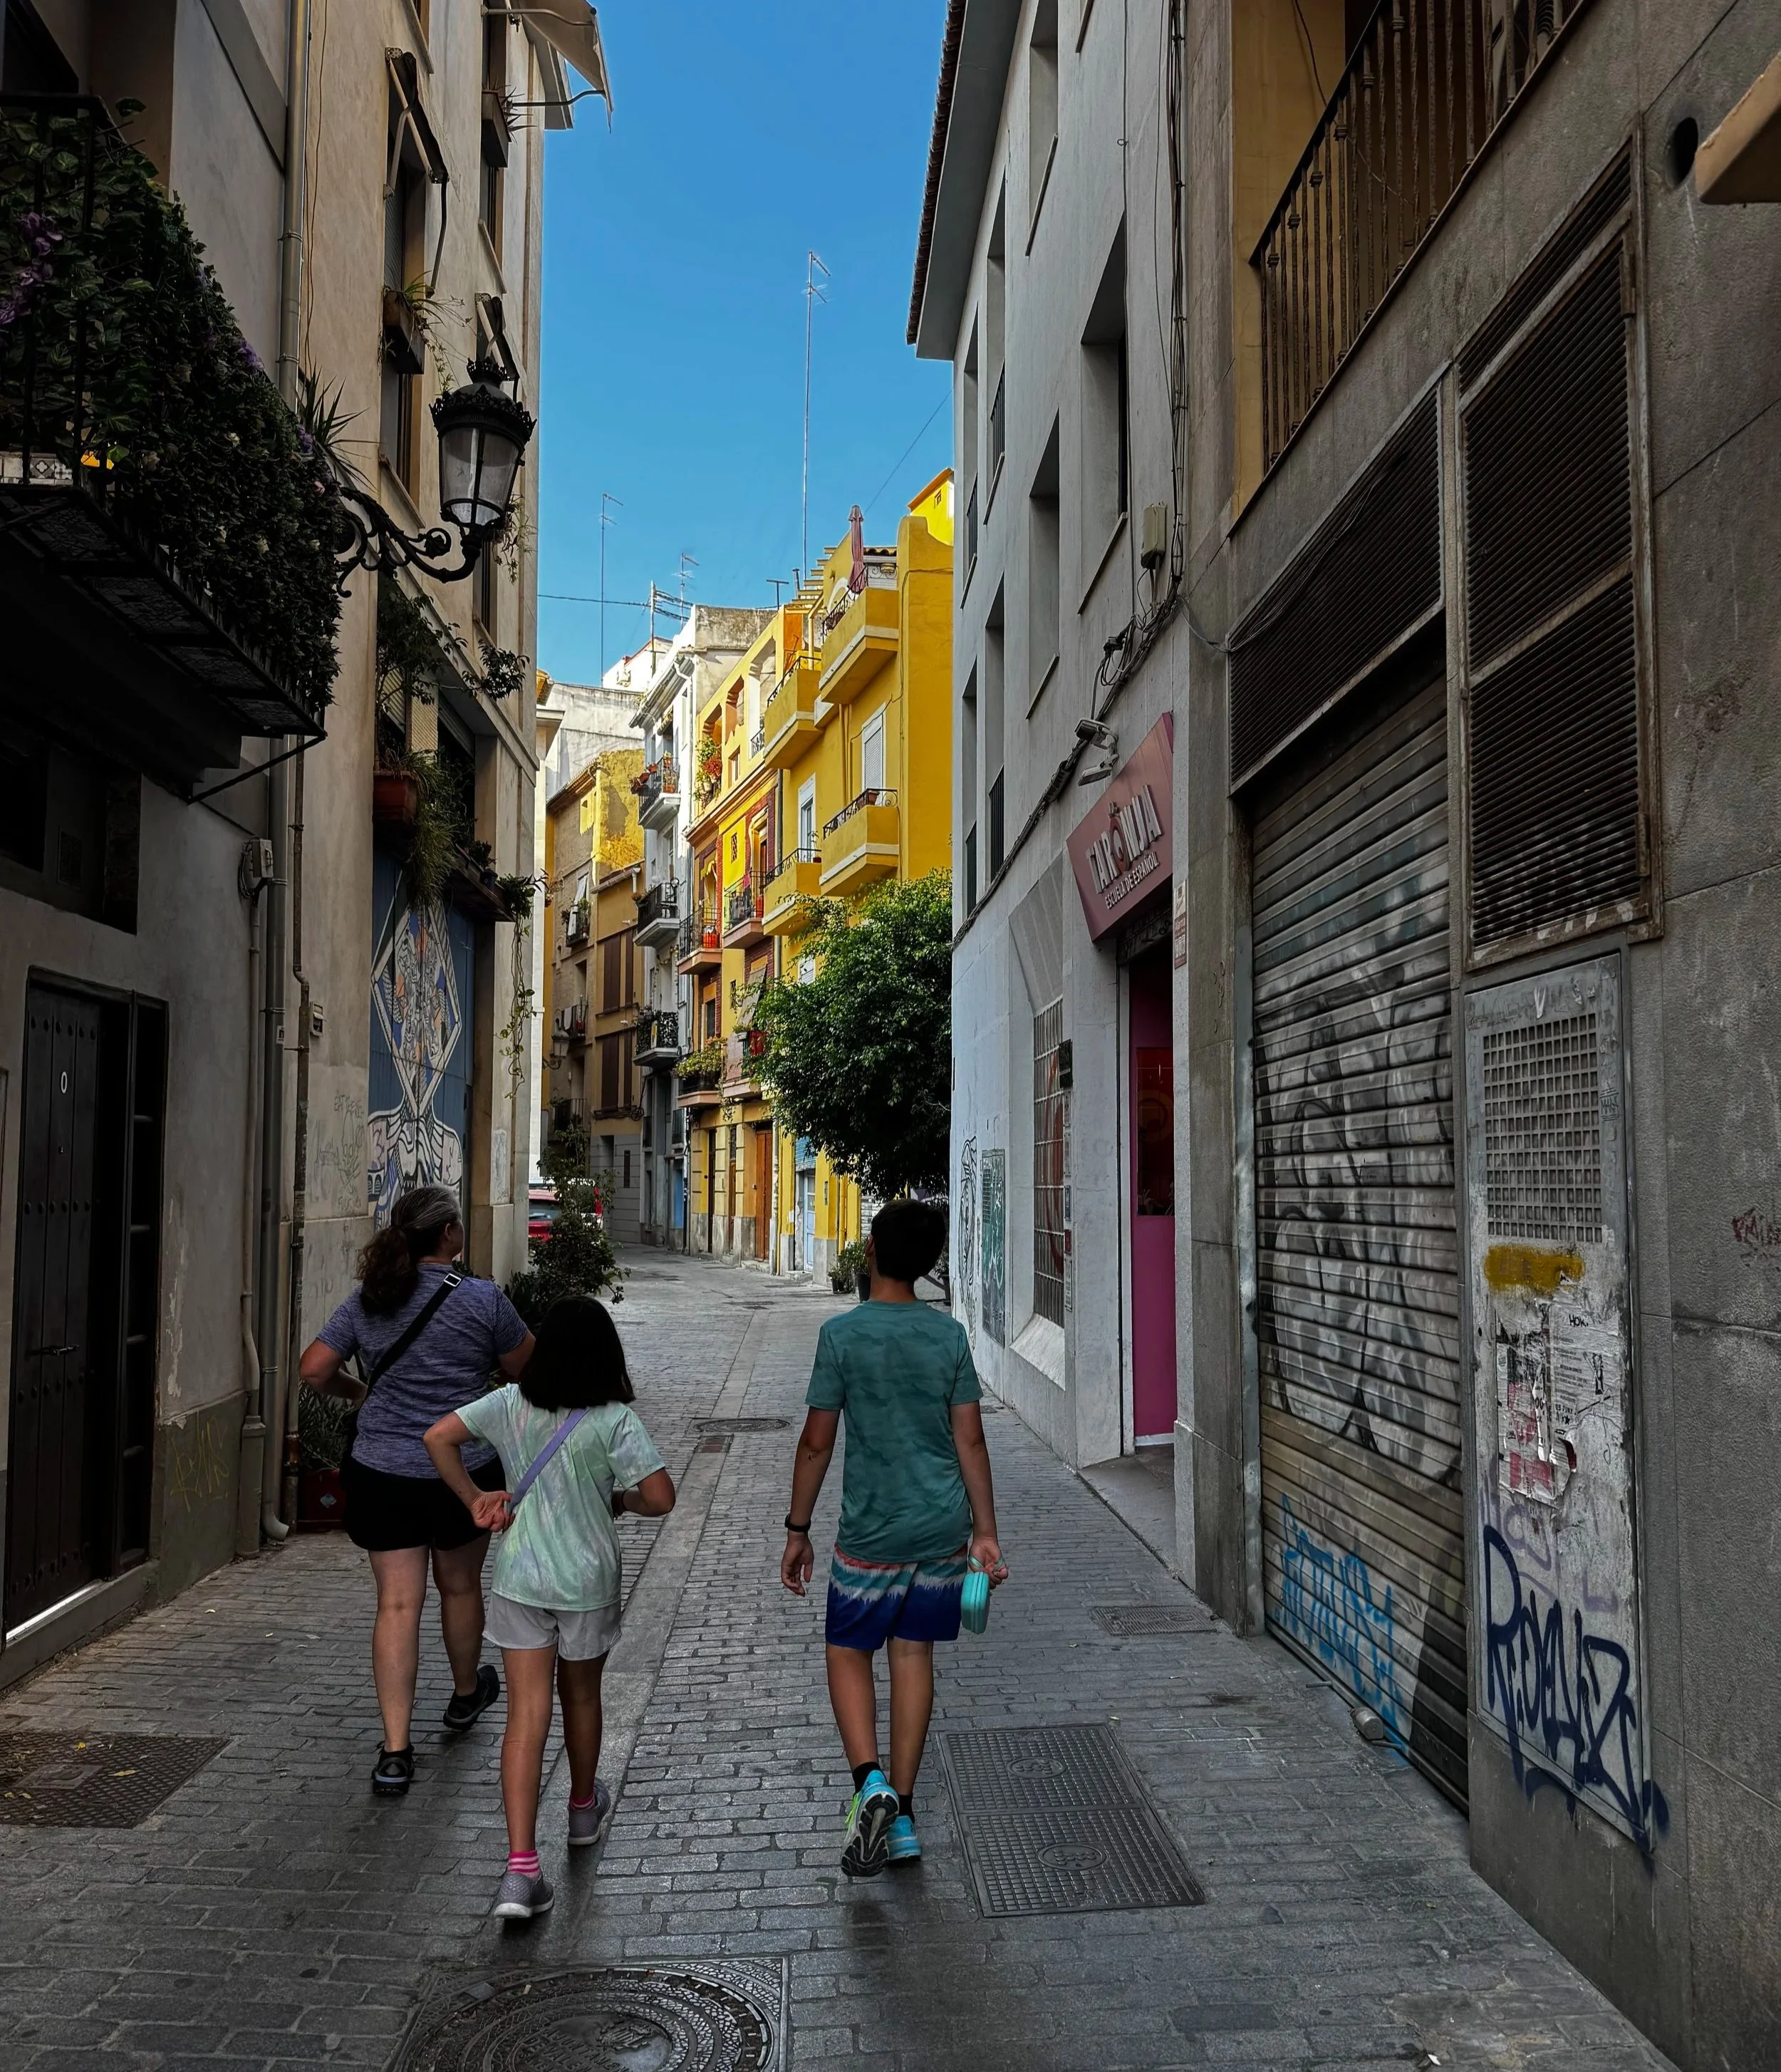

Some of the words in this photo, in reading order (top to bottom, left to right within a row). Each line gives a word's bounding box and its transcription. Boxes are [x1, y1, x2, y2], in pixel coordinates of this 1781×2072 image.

[1085, 784, 1162, 894] TARONJA
[1105, 881, 1126, 909] ESCUELA
[1125, 874, 1133, 891] DE
[541, 2029, 631, 2072] AJUNTAMEN
